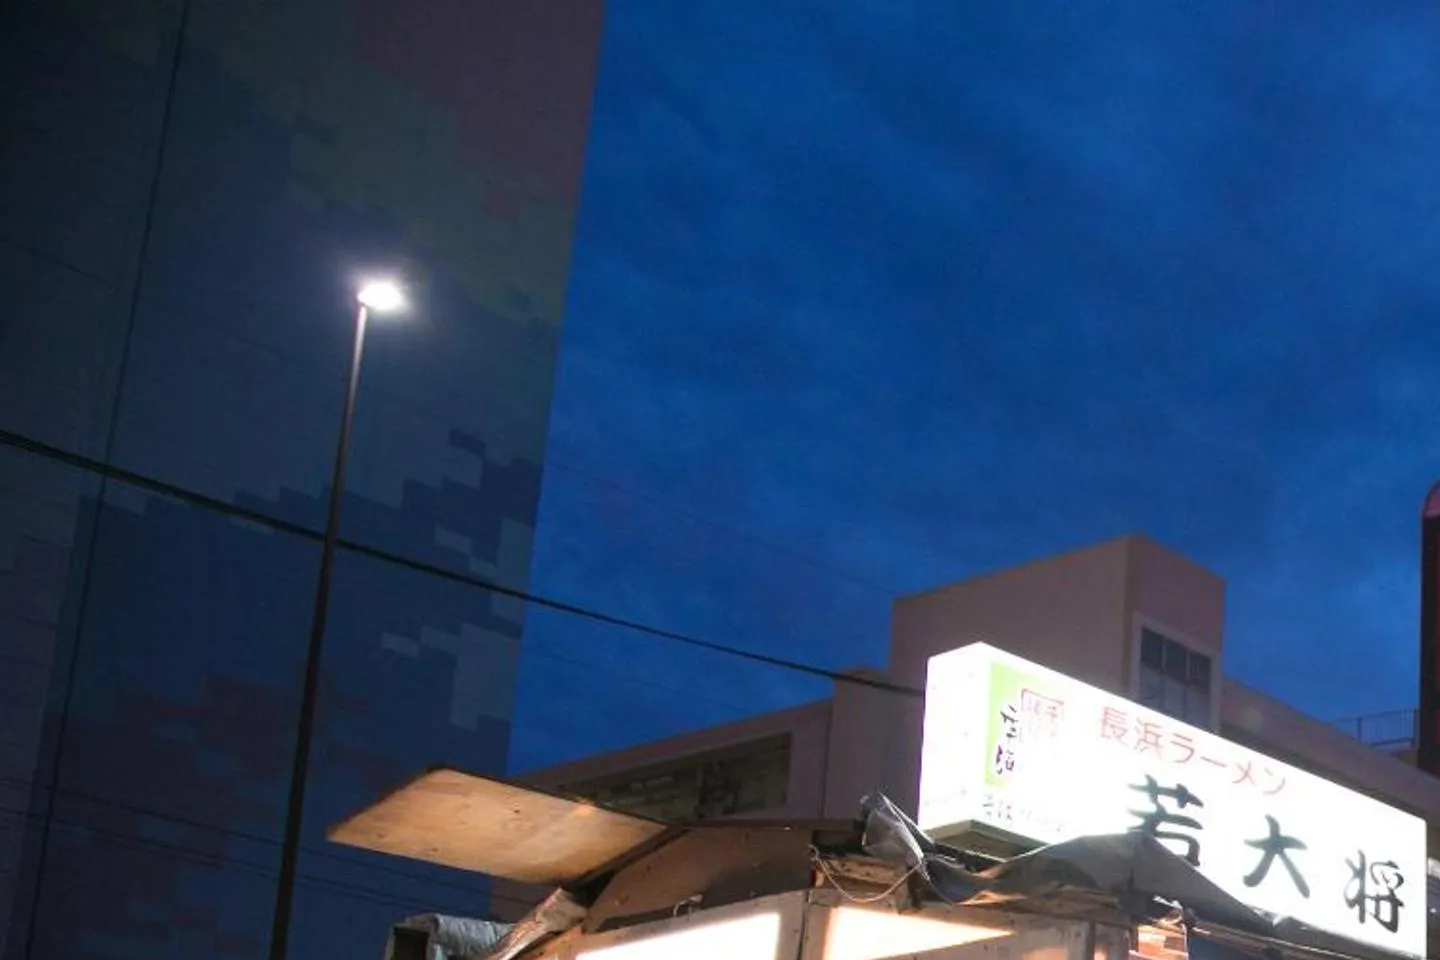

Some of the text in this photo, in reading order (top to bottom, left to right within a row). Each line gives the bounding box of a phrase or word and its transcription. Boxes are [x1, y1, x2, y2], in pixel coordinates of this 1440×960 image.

[1099, 704, 1287, 797] 長浜ラーメン
[1126, 774, 1406, 933] 若大将
